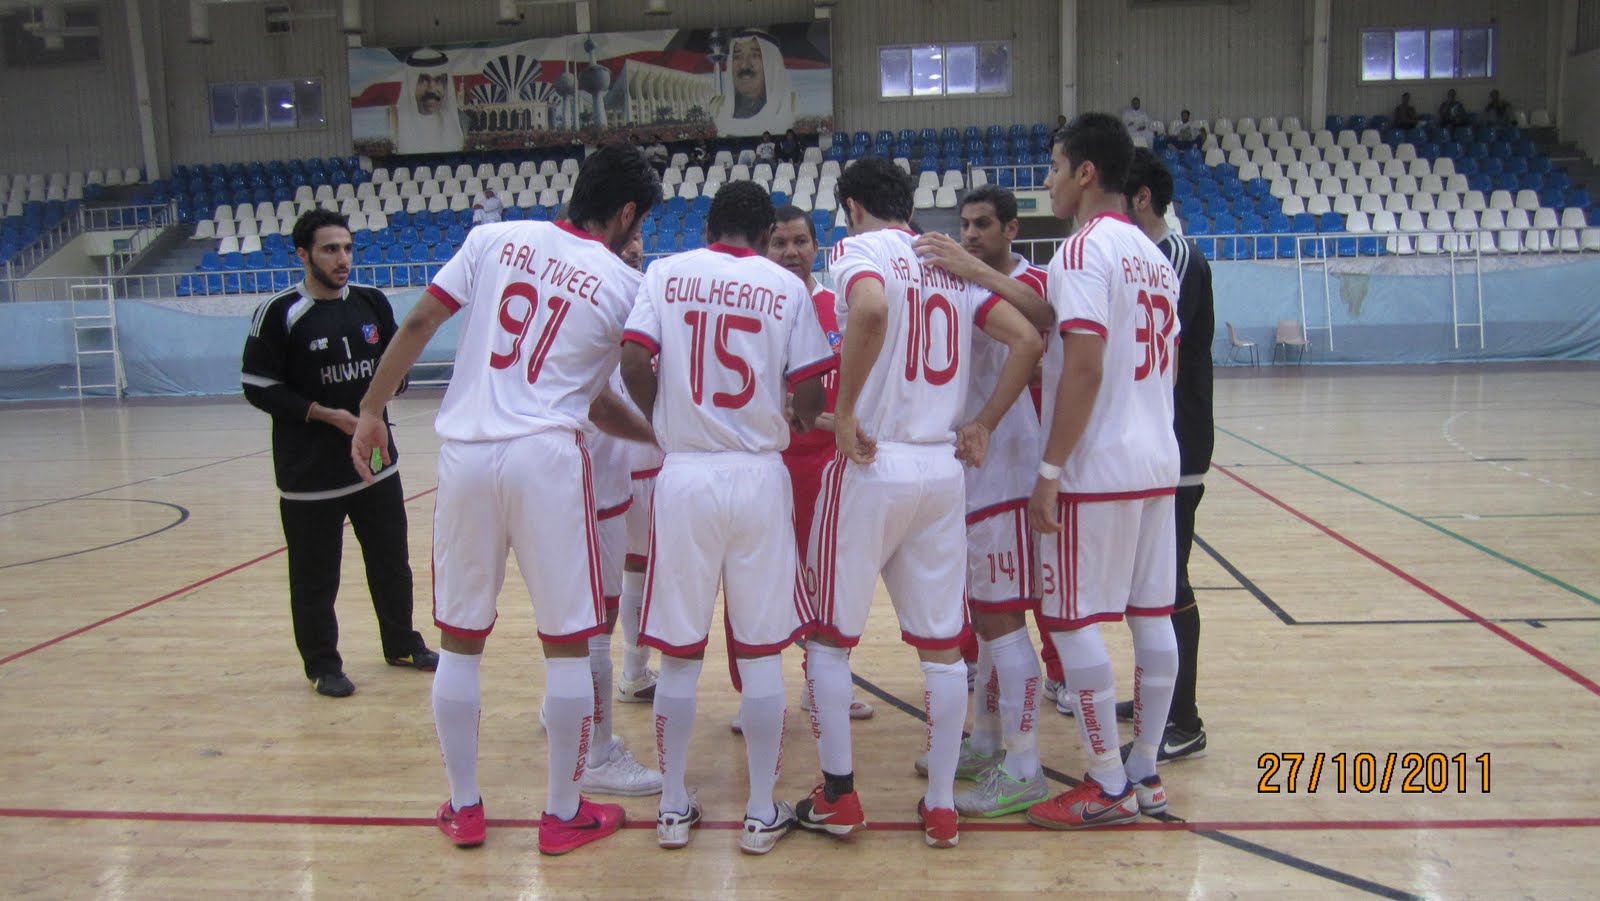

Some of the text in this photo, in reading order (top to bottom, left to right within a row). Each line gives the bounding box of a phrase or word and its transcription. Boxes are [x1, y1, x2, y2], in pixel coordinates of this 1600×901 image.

[540, 257, 602, 306] TWEEL
[665, 277, 787, 320] GUILHERME
[342, 336, 352, 360] 1
[490, 282, 571, 385] 91
[905, 287, 960, 386] 10
[321, 358, 375, 385] KUWAI
[684, 310, 762, 409] 15
[987, 550, 1015, 584] 14
[1043, 563, 1056, 595] 3
